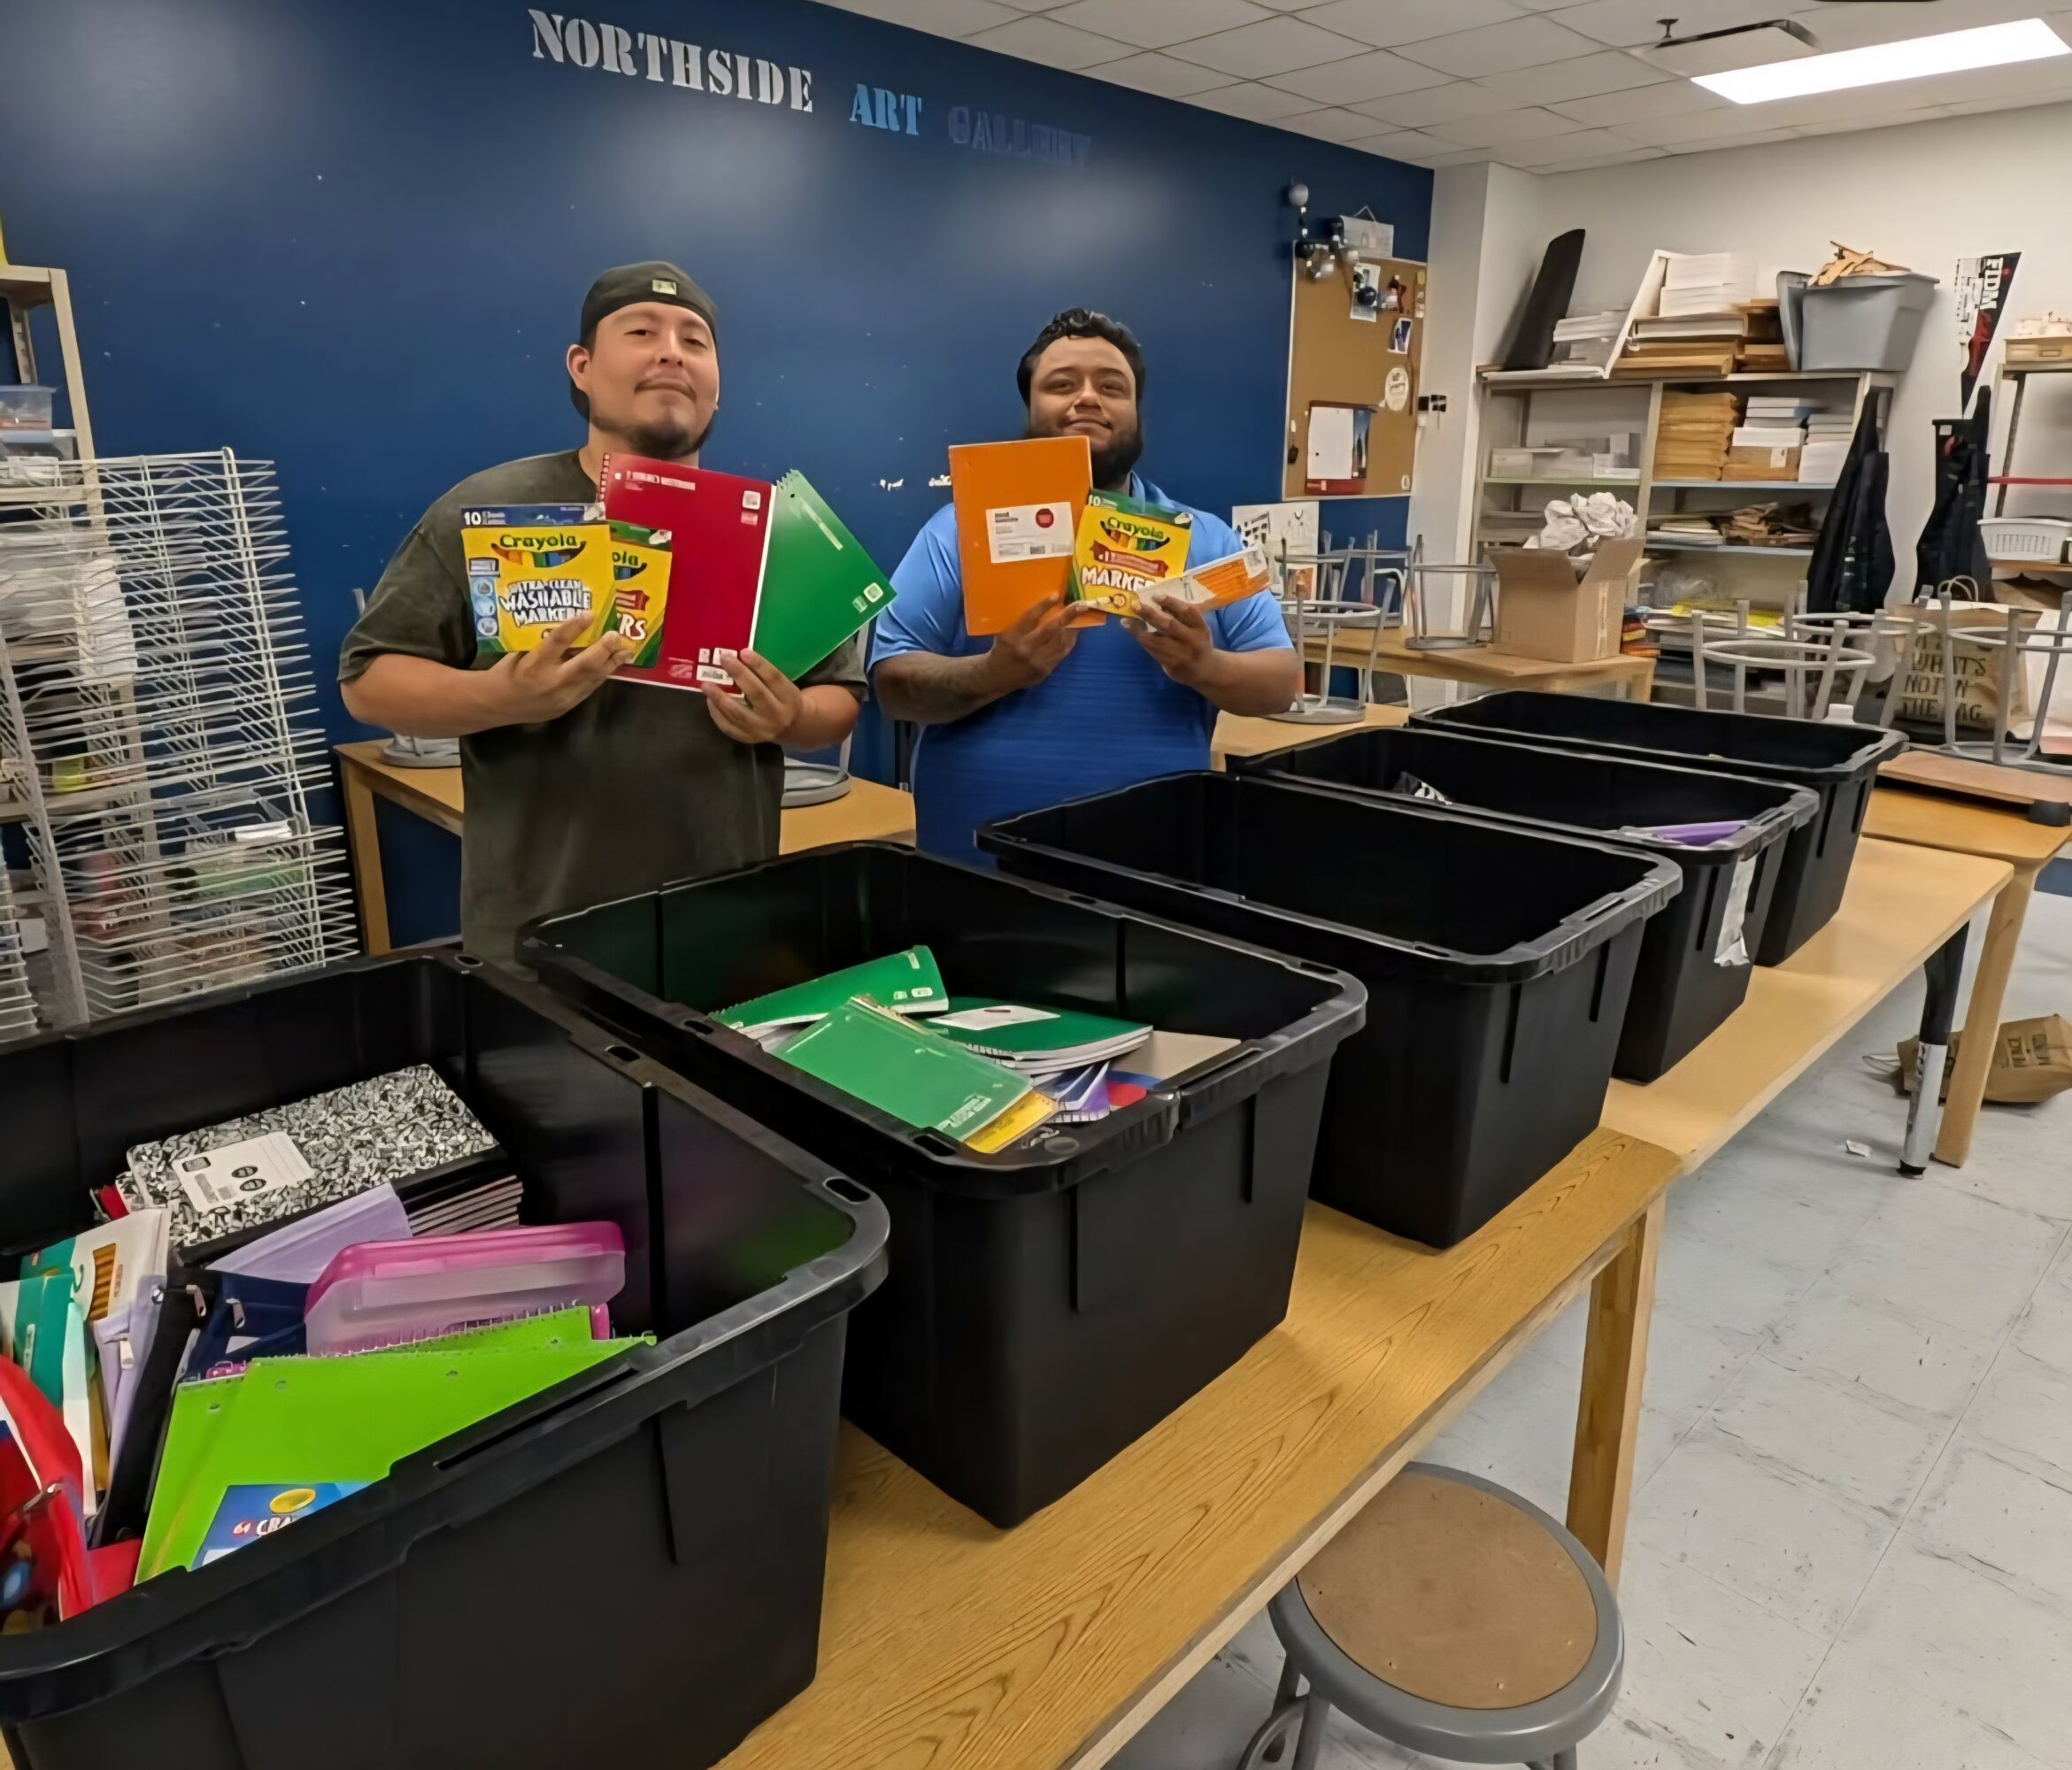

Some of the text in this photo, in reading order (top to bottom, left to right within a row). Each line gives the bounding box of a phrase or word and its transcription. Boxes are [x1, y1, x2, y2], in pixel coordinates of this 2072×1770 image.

[528, 9, 813, 112] NORTHSIDE
[849, 83, 922, 135] ART
[464, 512, 481, 526] 10
[1107, 517, 1164, 540] Crayola
[499, 534, 577, 550] Crayola
